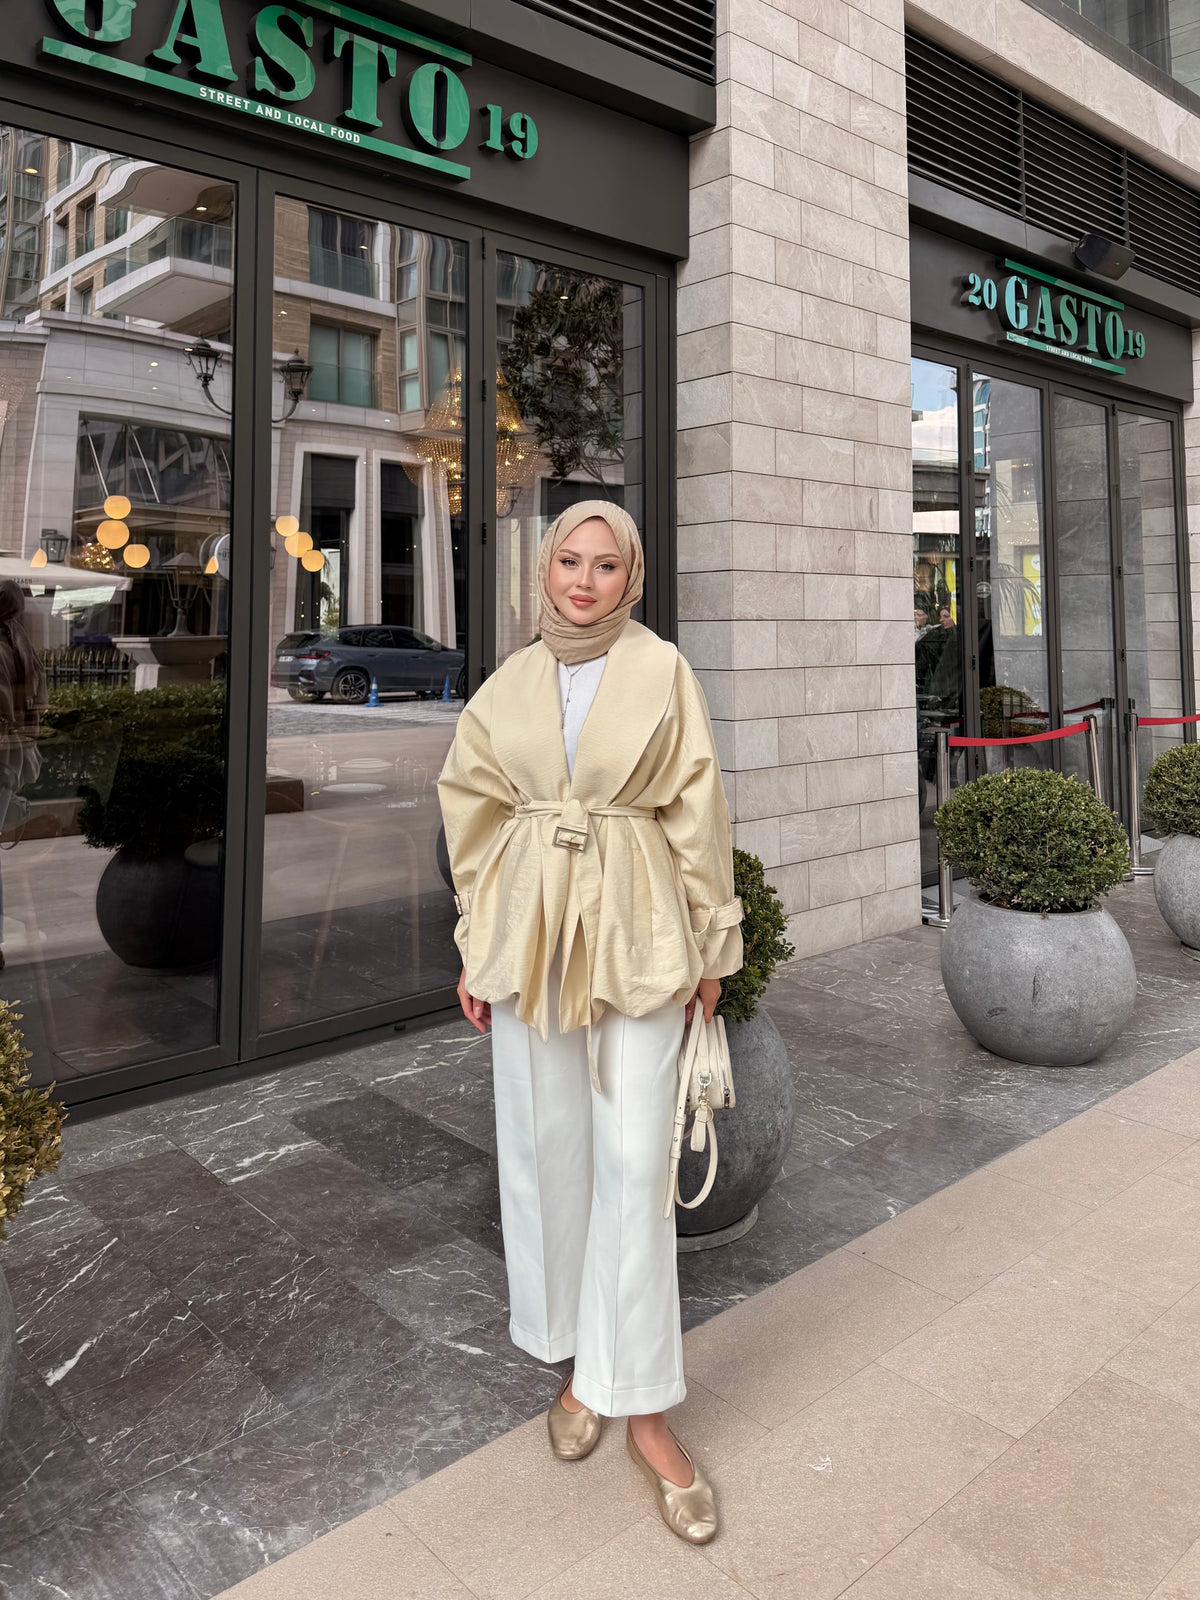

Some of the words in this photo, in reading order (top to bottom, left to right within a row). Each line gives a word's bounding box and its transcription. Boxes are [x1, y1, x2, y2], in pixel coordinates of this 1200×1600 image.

[199, 87, 250, 110] STREET
[255, 104, 282, 120] AND
[287, 113, 326, 134] LOCAL
[330, 126, 361, 144] FOOD
[486, 103, 539, 159] 19
[968, 272, 998, 310] 20
[1005, 275, 1125, 360] GASTO
[1127, 329, 1146, 359] 19
